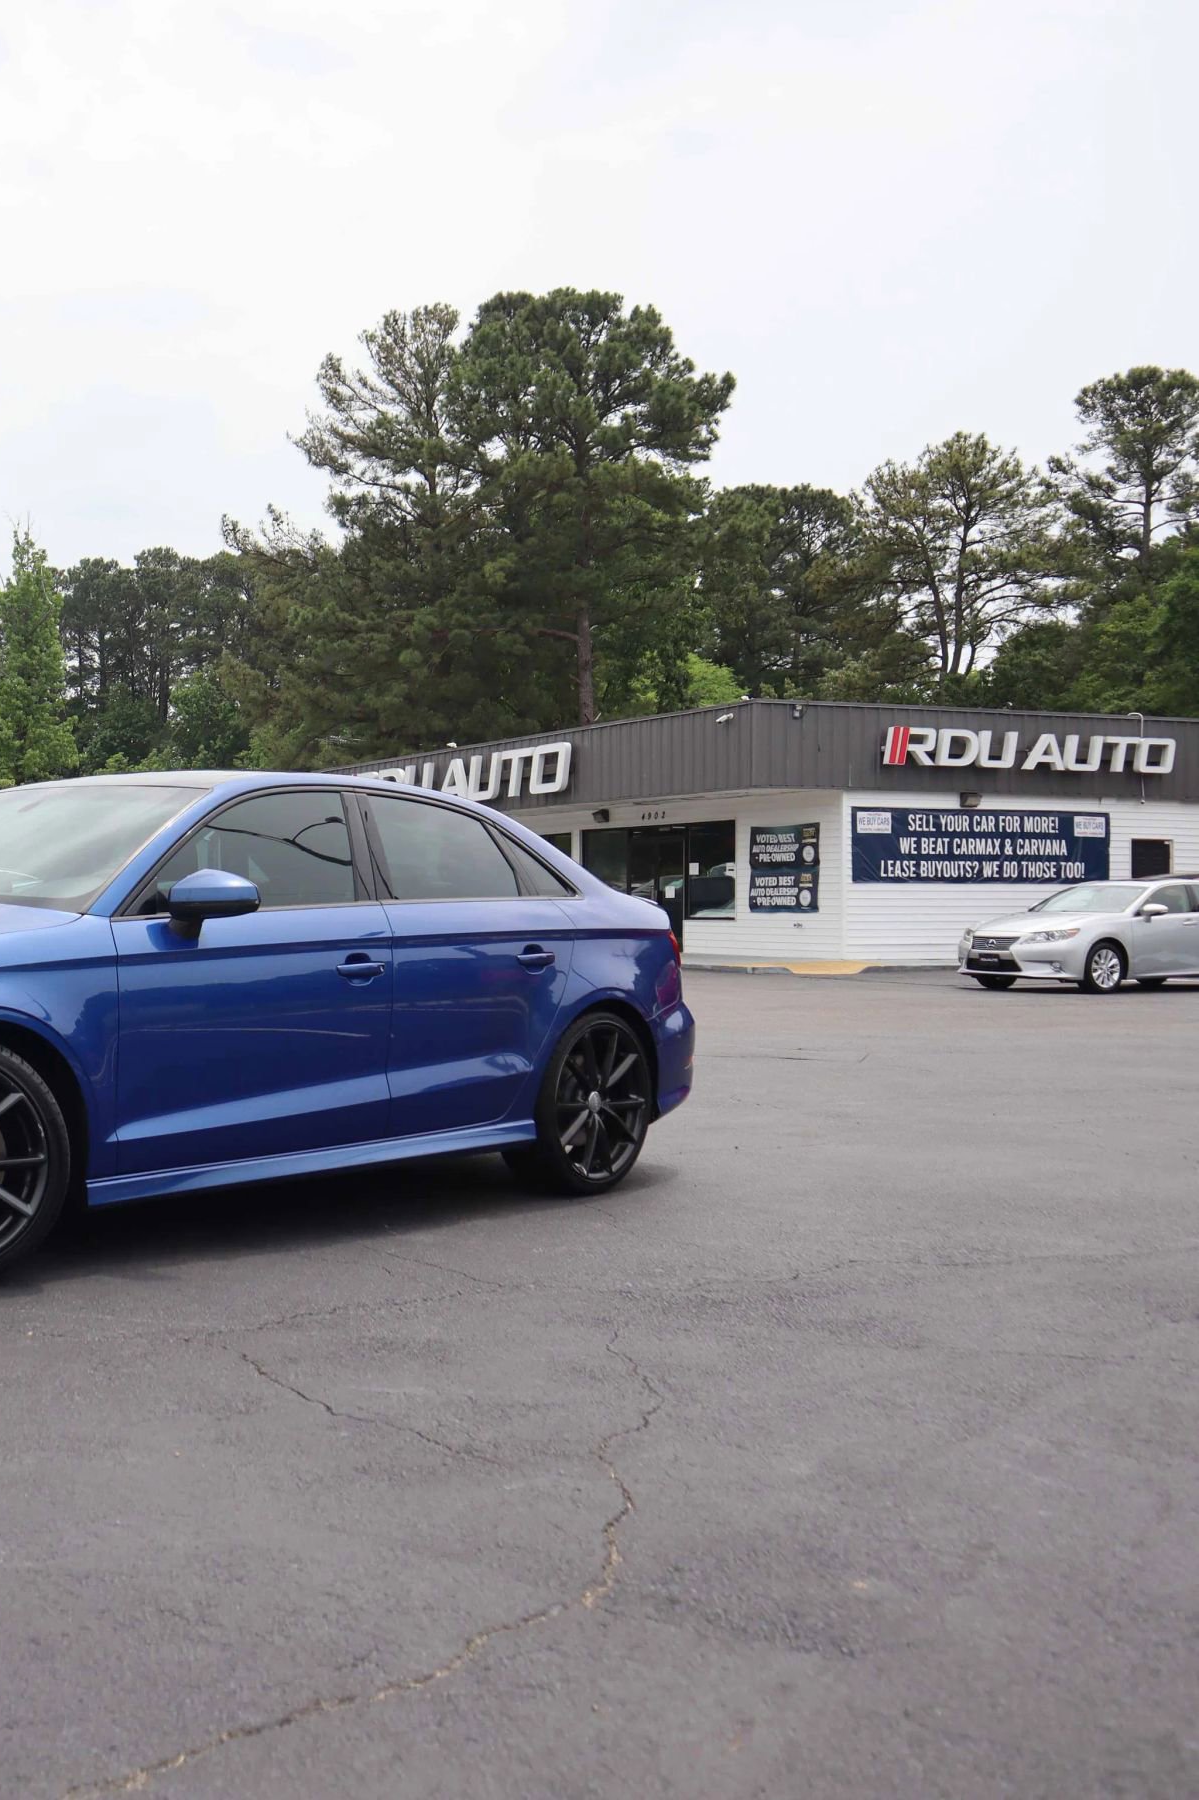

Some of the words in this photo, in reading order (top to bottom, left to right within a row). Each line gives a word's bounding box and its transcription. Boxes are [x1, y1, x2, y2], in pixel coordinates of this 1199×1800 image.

[905, 727, 1018, 768] RDU
[1021, 733, 1176, 774] AUTO
[441, 742, 571, 801] AUTO
[908, 814, 936, 831] SELL
[940, 815, 970, 832] YOUR
[973, 815, 996, 832] CAR
[999, 815, 1021, 832] FOR
[1024, 816, 1059, 833] MORE!
[756, 834, 778, 843] VOTED
[778, 833, 795, 843] BEST
[899, 837, 917, 854] WE
[921, 838, 949, 854] BEAT
[953, 838, 1001, 855] CARMAX
[1004, 838, 1013, 855] &
[1016, 839, 1068, 856] CARVANA
[880, 860, 916, 877] LEASE
[921, 860, 979, 878] BUYOUTS?
[982, 861, 1000, 878] WE
[1003, 861, 1018, 878] DO
[1021, 861, 1057, 878] THOSE
[1060, 861, 1085, 879] TOO!
[755, 877, 777, 886] VOTED
[778, 876, 795, 886] BEST
[750, 888, 765, 896] AUTO
[766, 887, 798, 896] DEALERSHIP
